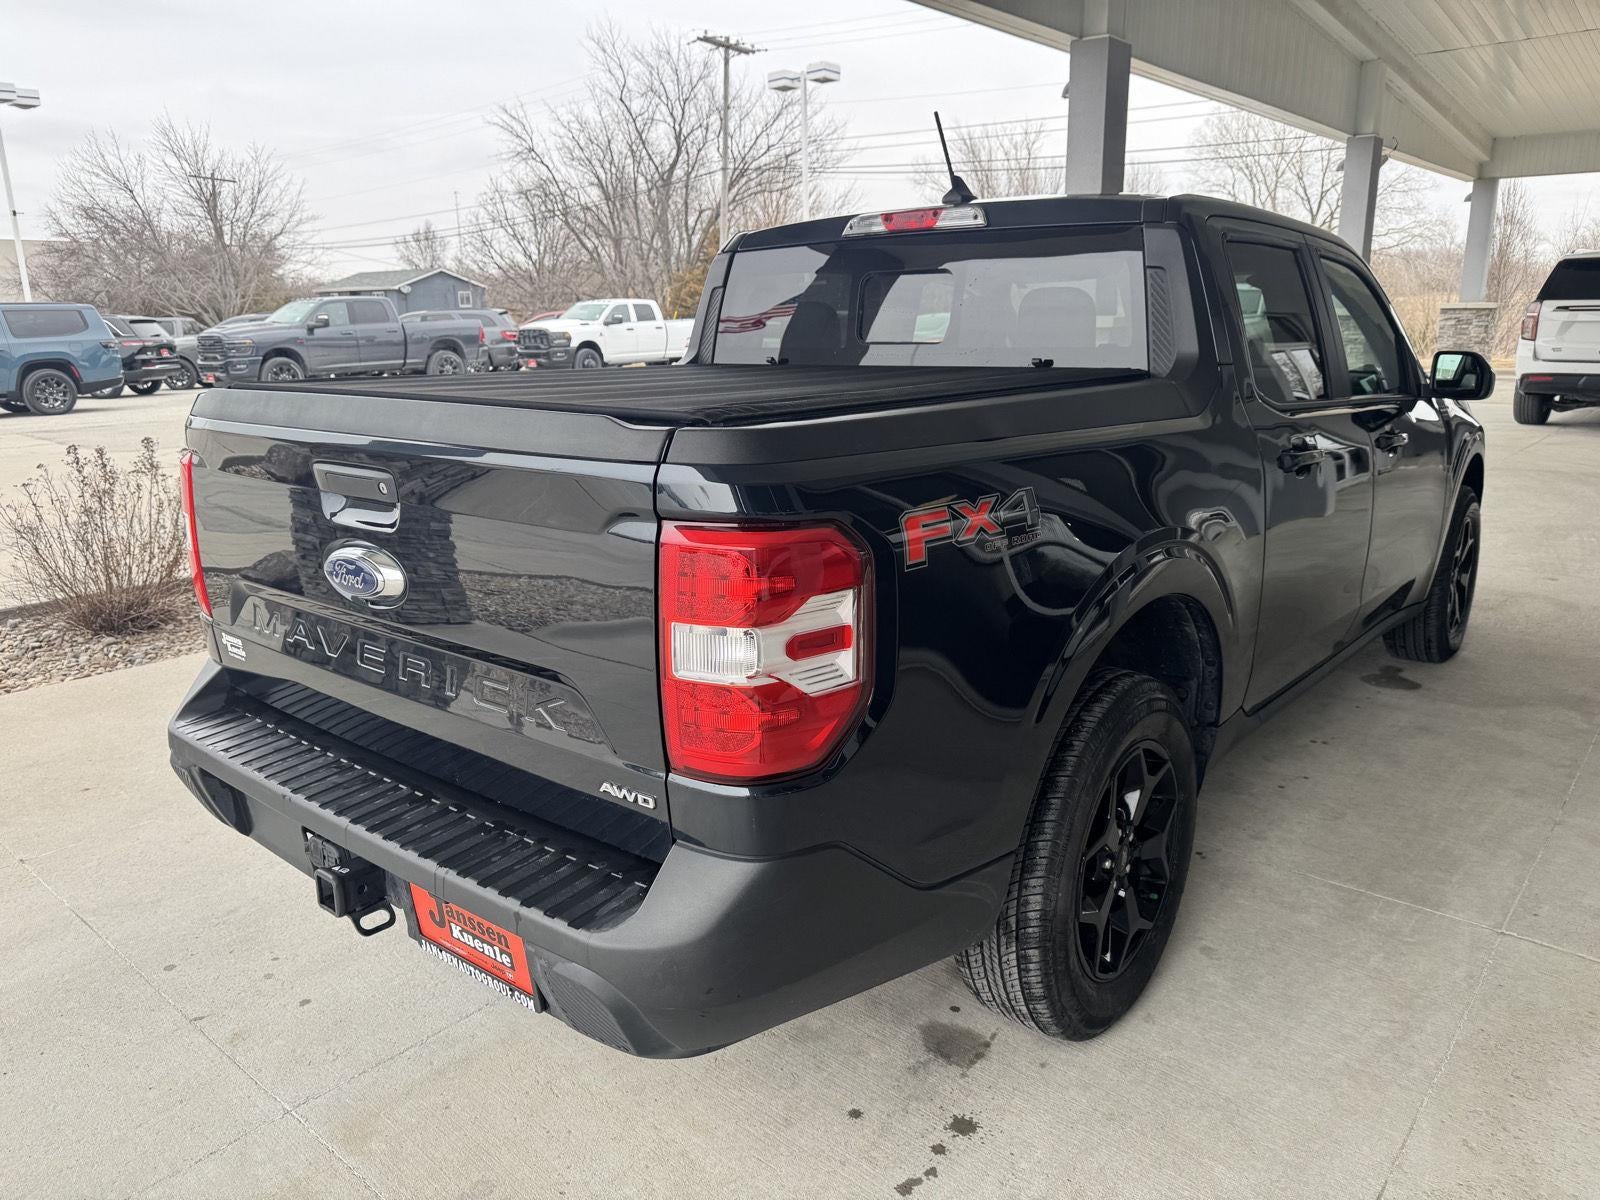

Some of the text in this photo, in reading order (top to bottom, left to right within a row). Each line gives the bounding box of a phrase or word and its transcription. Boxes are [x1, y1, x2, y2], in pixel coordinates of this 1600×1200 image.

[898, 486, 1042, 572] FX4
[984, 531, 1042, 552] OFF ROAD
[333, 560, 364, 589] Ford
[252, 602, 567, 732] MAVERICK
[599, 782, 657, 809] AWD
[428, 891, 510, 950] Janssen
[449, 922, 512, 967] Kuenle
